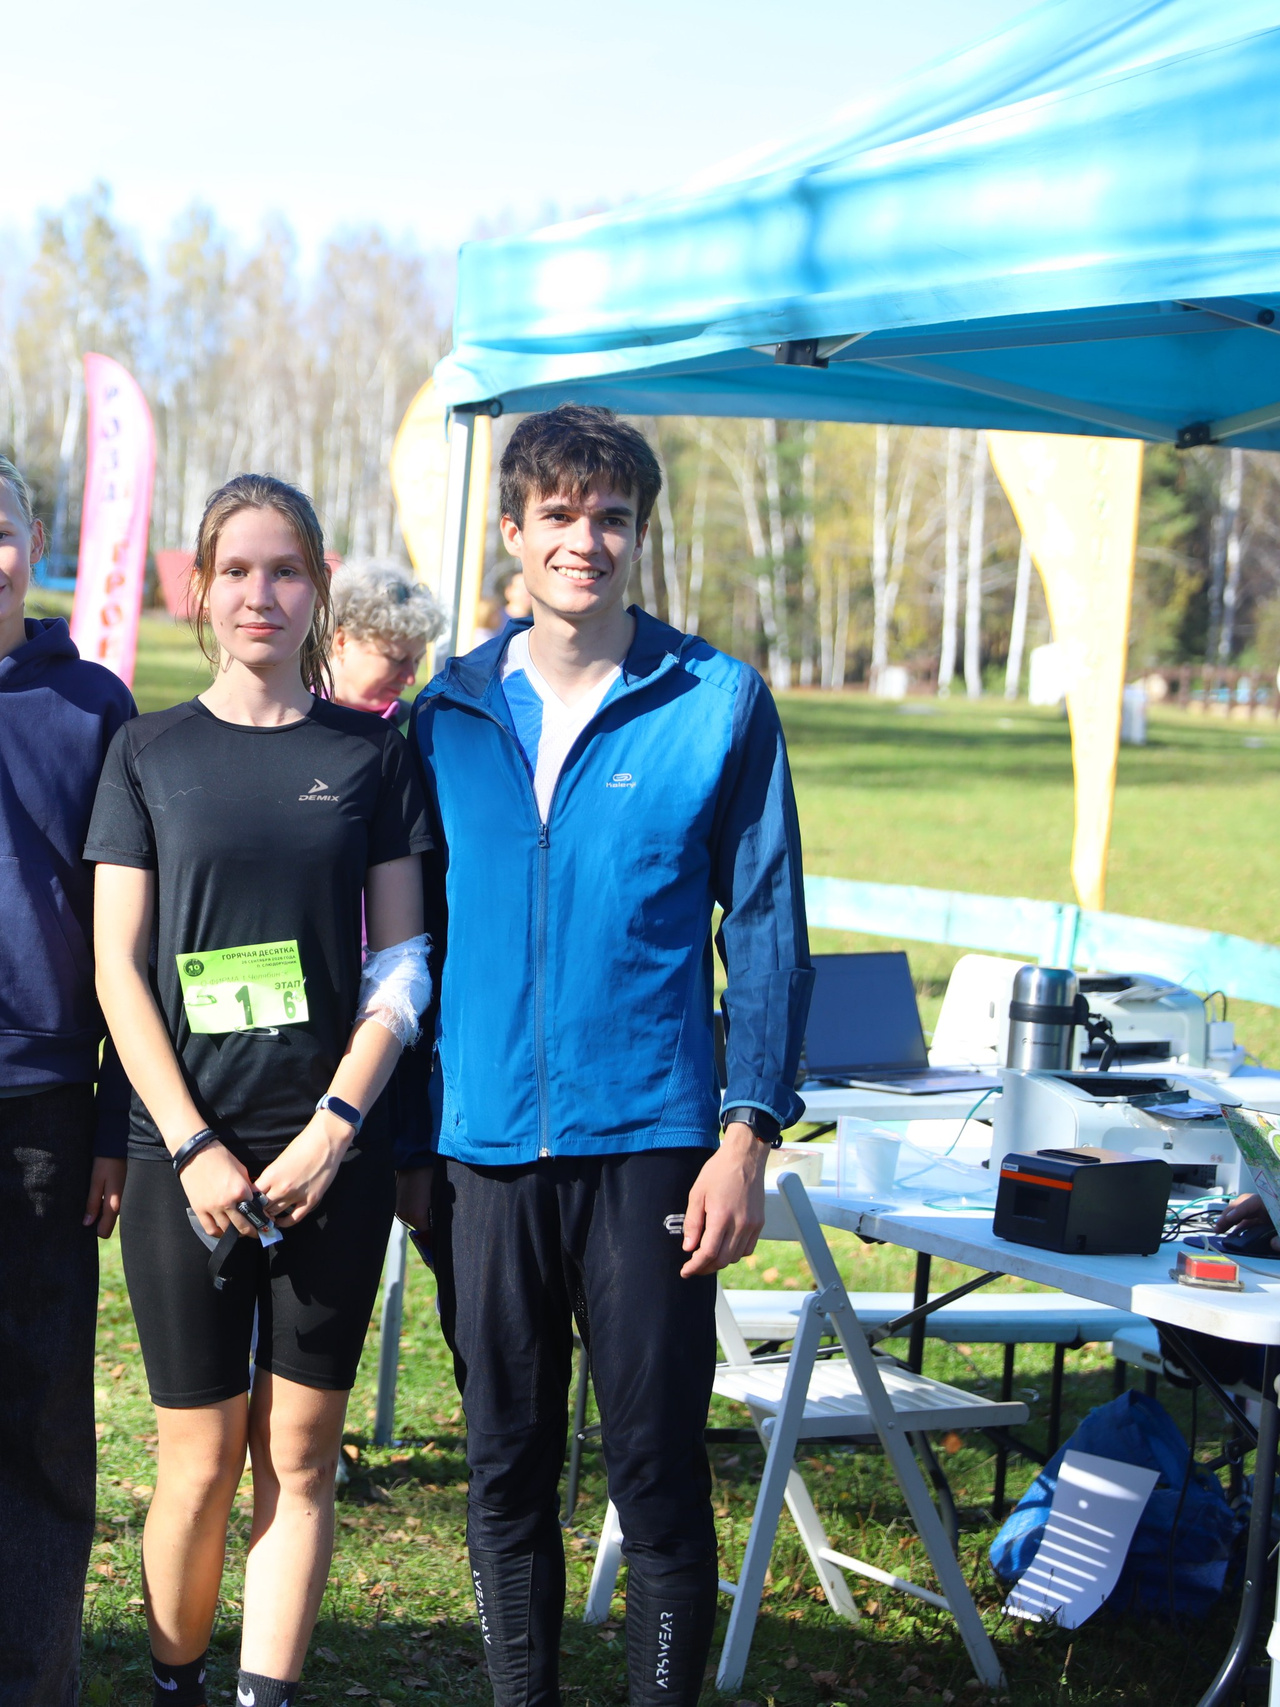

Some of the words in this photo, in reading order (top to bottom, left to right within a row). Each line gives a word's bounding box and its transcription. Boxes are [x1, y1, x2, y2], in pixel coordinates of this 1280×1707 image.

[298, 794, 340, 802] DEMIX
[222, 950, 258, 960] ГОРЯЧАЯ
[259, 946, 294, 957] ДЕСЯТКА
[274, 980, 301, 990] ЭТАП
[235, 985, 253, 1026] 1
[283, 990, 296, 1019] 6
[655, 1611, 673, 1689] ARSWEAR
